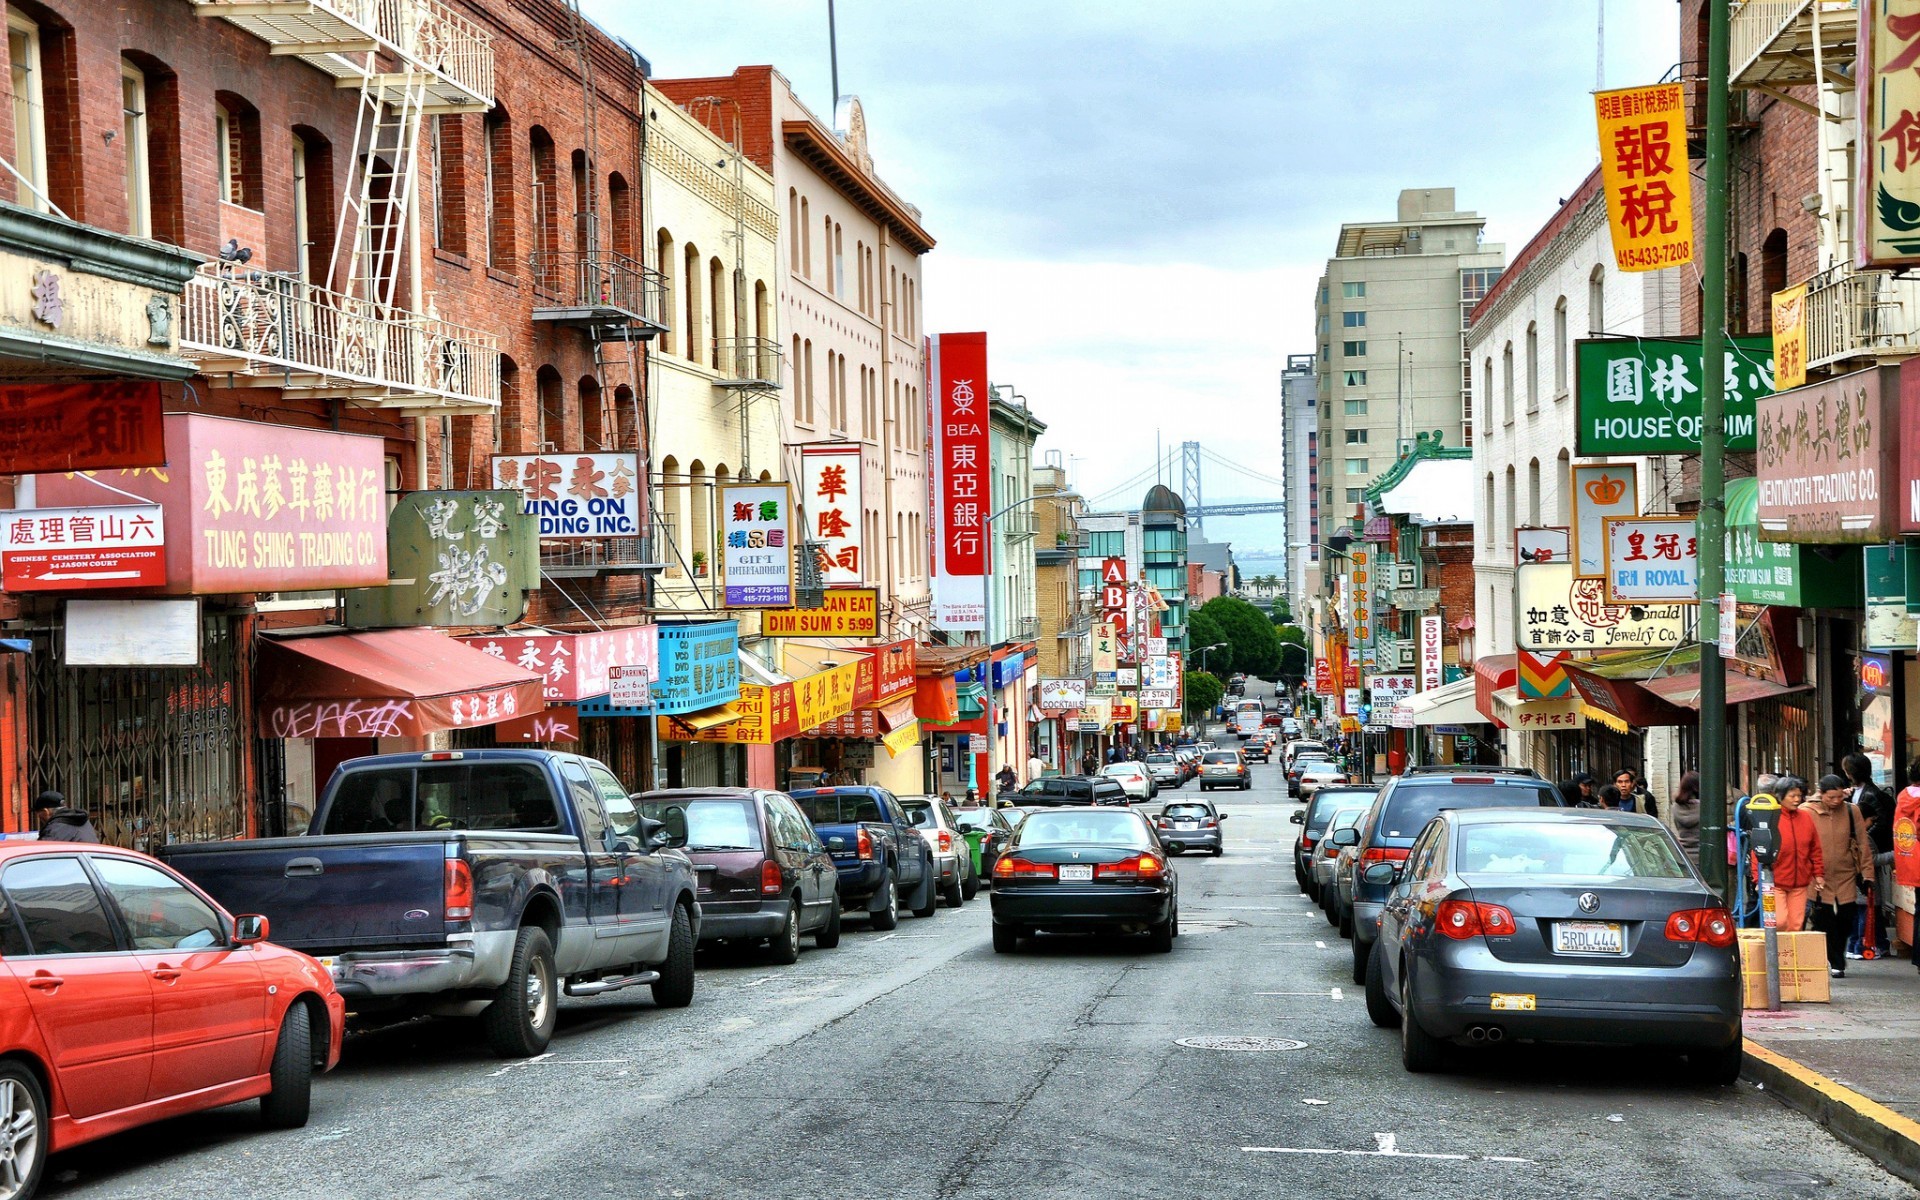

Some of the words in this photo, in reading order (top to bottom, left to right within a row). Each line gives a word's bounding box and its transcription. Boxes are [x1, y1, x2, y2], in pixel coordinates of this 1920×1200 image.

[1618, 241, 1690, 267] 415-433-7208
[946, 424, 982, 436] BEA
[1594, 417, 1673, 439] HOUSE
[1758, 476, 1812, 507] WENTWORTH
[1812, 471, 1857, 504] TRADING
[1859, 467, 1878, 501] CO.
[587, 498, 625, 516] ON
[951, 444, 979, 556] 東亞銀行
[596, 516, 636, 533] INC.
[204, 529, 248, 568] TUNG
[253, 530, 295, 568] SHING
[299, 532, 353, 567] TRADING
[357, 531, 377, 566] CO.
[10, 555, 48, 563] CHINESE
[52, 553, 97, 562] CEMETERY
[99, 551, 156, 560] ASSOCIATION
[739, 555, 774, 564] GIFT
[1644, 570, 1690, 587] ROYAL
[1758, 568, 1772, 585] SUM
[742, 586, 788, 594] 415-773-1151
[742, 594, 788, 602] 415-773-1161
[821, 596, 847, 612] CAN
[850, 597, 873, 612] EAT
[769, 615, 796, 631] DIM
[800, 615, 832, 631] SUM
[848, 617, 874, 631] 5.99
[1527, 604, 1570, 626] 如意
[1529, 628, 1596, 644] 首飾公司
[1604, 626, 1656, 646] Jewelry
[1658, 627, 1678, 642] Co.
[1425, 619, 1438, 675] SOUVENIR
[610, 667, 621, 678] NO
[622, 669, 647, 677] PARKING
[1042, 680, 1060, 696] RED'S
[1063, 680, 1085, 695] PLACE
[1151, 690, 1170, 698] STAR
[1042, 700, 1085, 709] COCKTAILS
[1139, 699, 1164, 707] HEATER
[801, 714, 816, 730] Dick
[819, 709, 830, 722] Lee
[1561, 931, 1617, 947] 5RDL444
